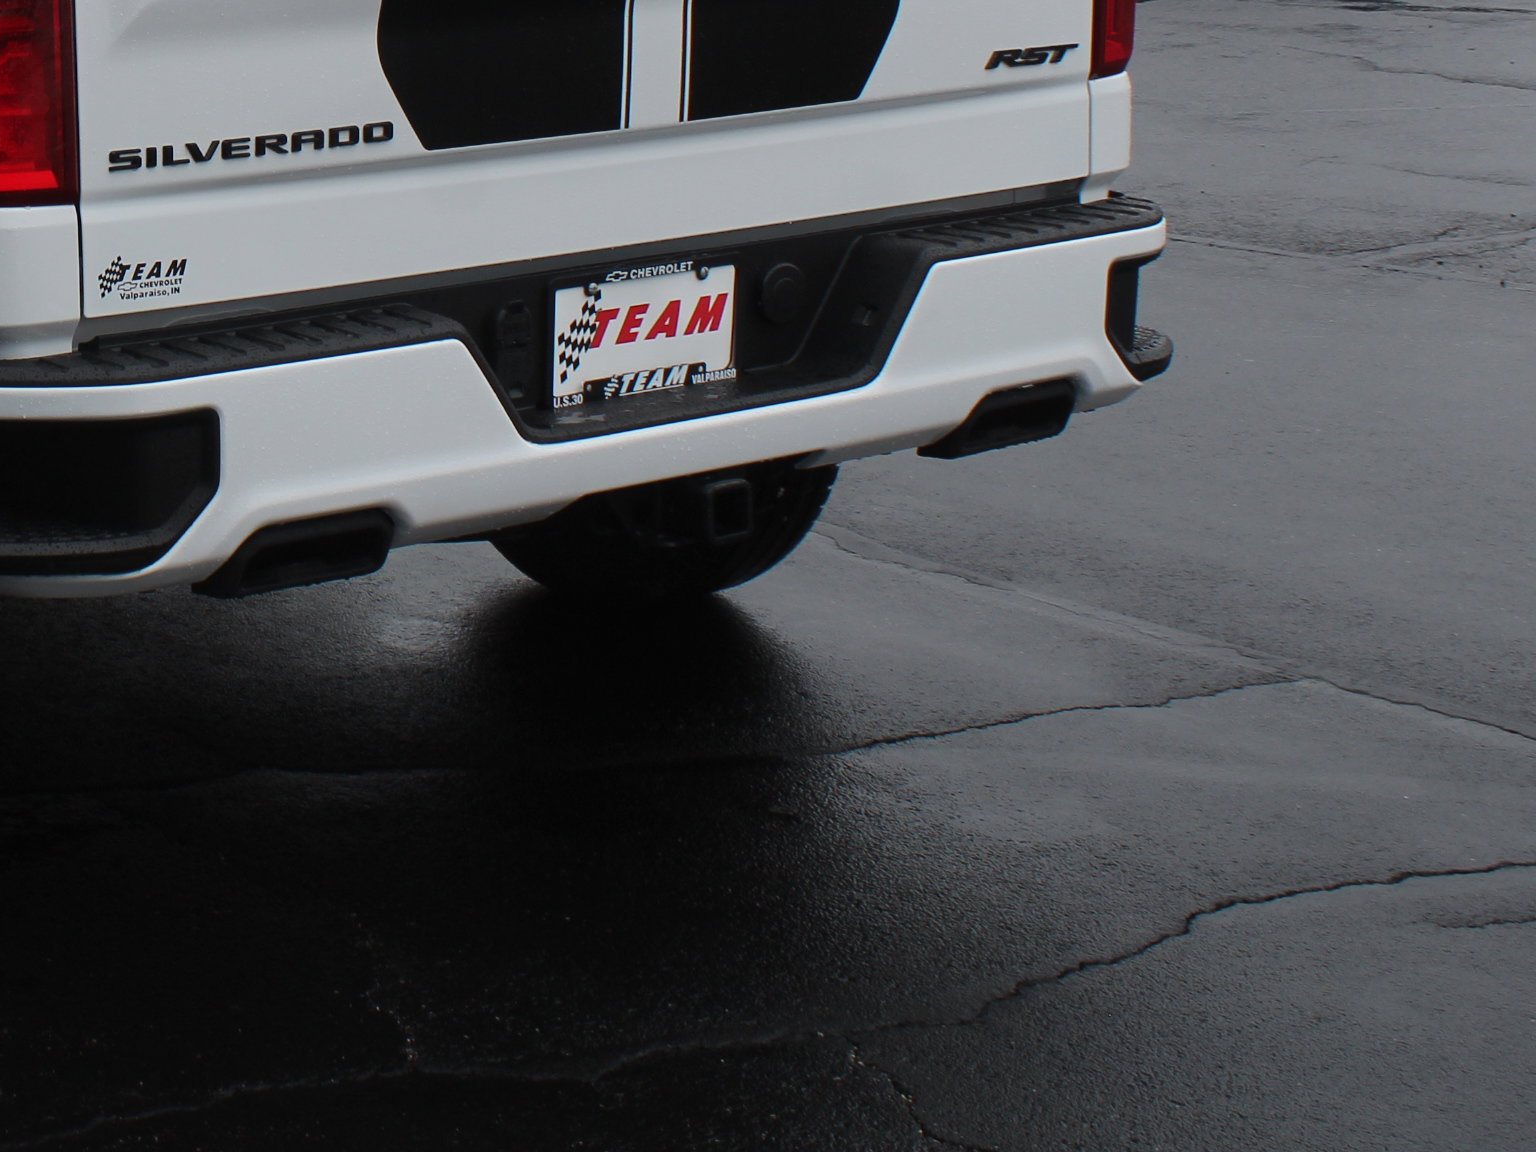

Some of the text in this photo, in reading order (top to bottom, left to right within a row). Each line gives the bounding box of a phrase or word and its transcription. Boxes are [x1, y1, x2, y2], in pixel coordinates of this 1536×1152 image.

[984, 43, 1079, 70] RST
[108, 121, 394, 172] SILVERADO
[116, 258, 187, 281] TEAM
[629, 261, 694, 280] CHEVROLET
[120, 287, 181, 300] Valparaiso, IN
[139, 278, 183, 289] CHEVROLET
[591, 293, 729, 349] TEAM
[619, 364, 689, 396] TEAM
[691, 368, 737, 385] VALPARAISO
